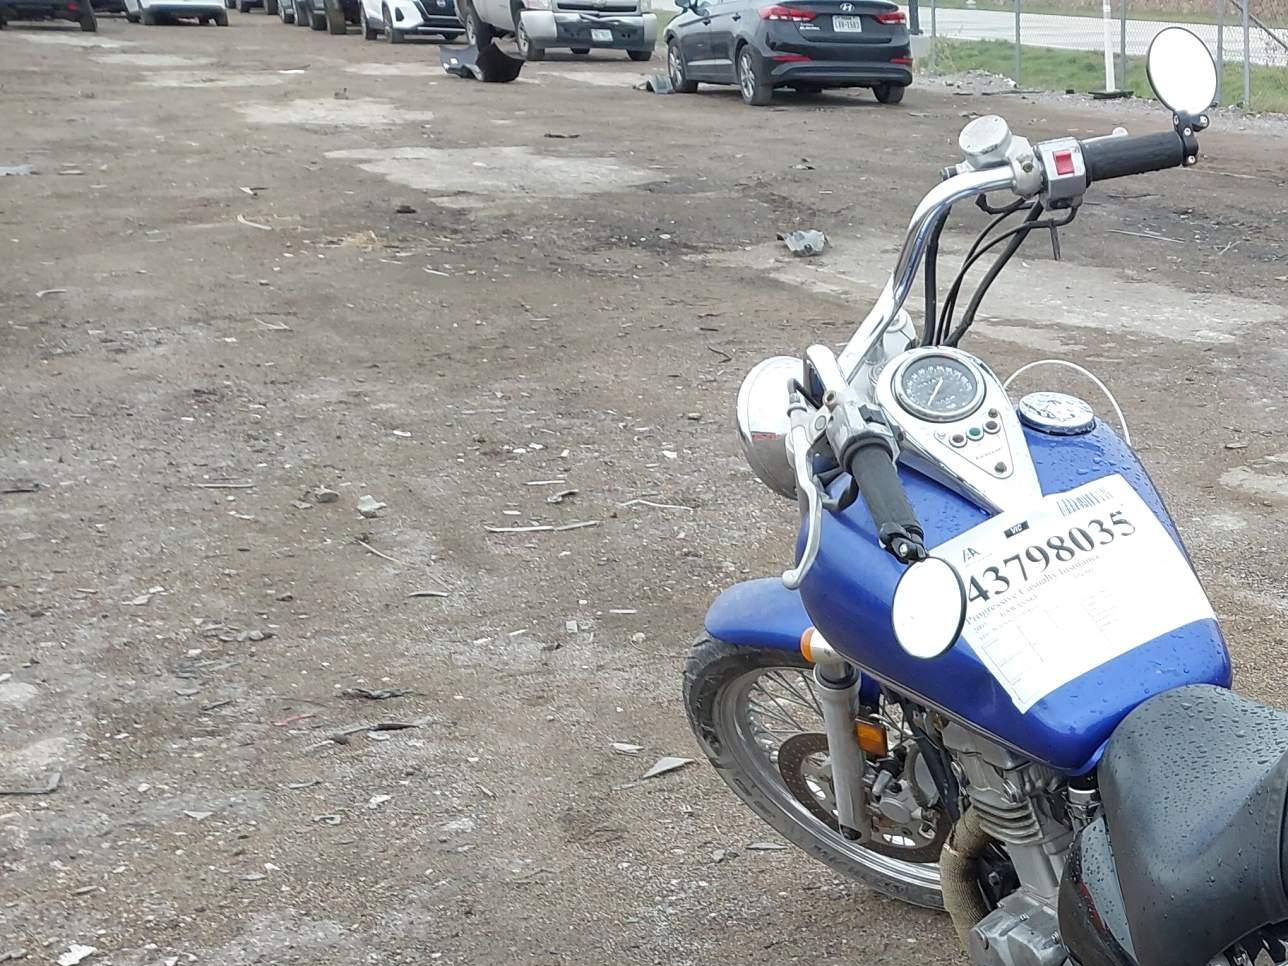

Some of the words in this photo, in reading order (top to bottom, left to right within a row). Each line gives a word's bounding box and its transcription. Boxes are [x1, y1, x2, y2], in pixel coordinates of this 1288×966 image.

[967, 510, 1136, 602] 43798035
[966, 592, 1018, 625] Progressive
[1019, 573, 1057, 596] Casualty
